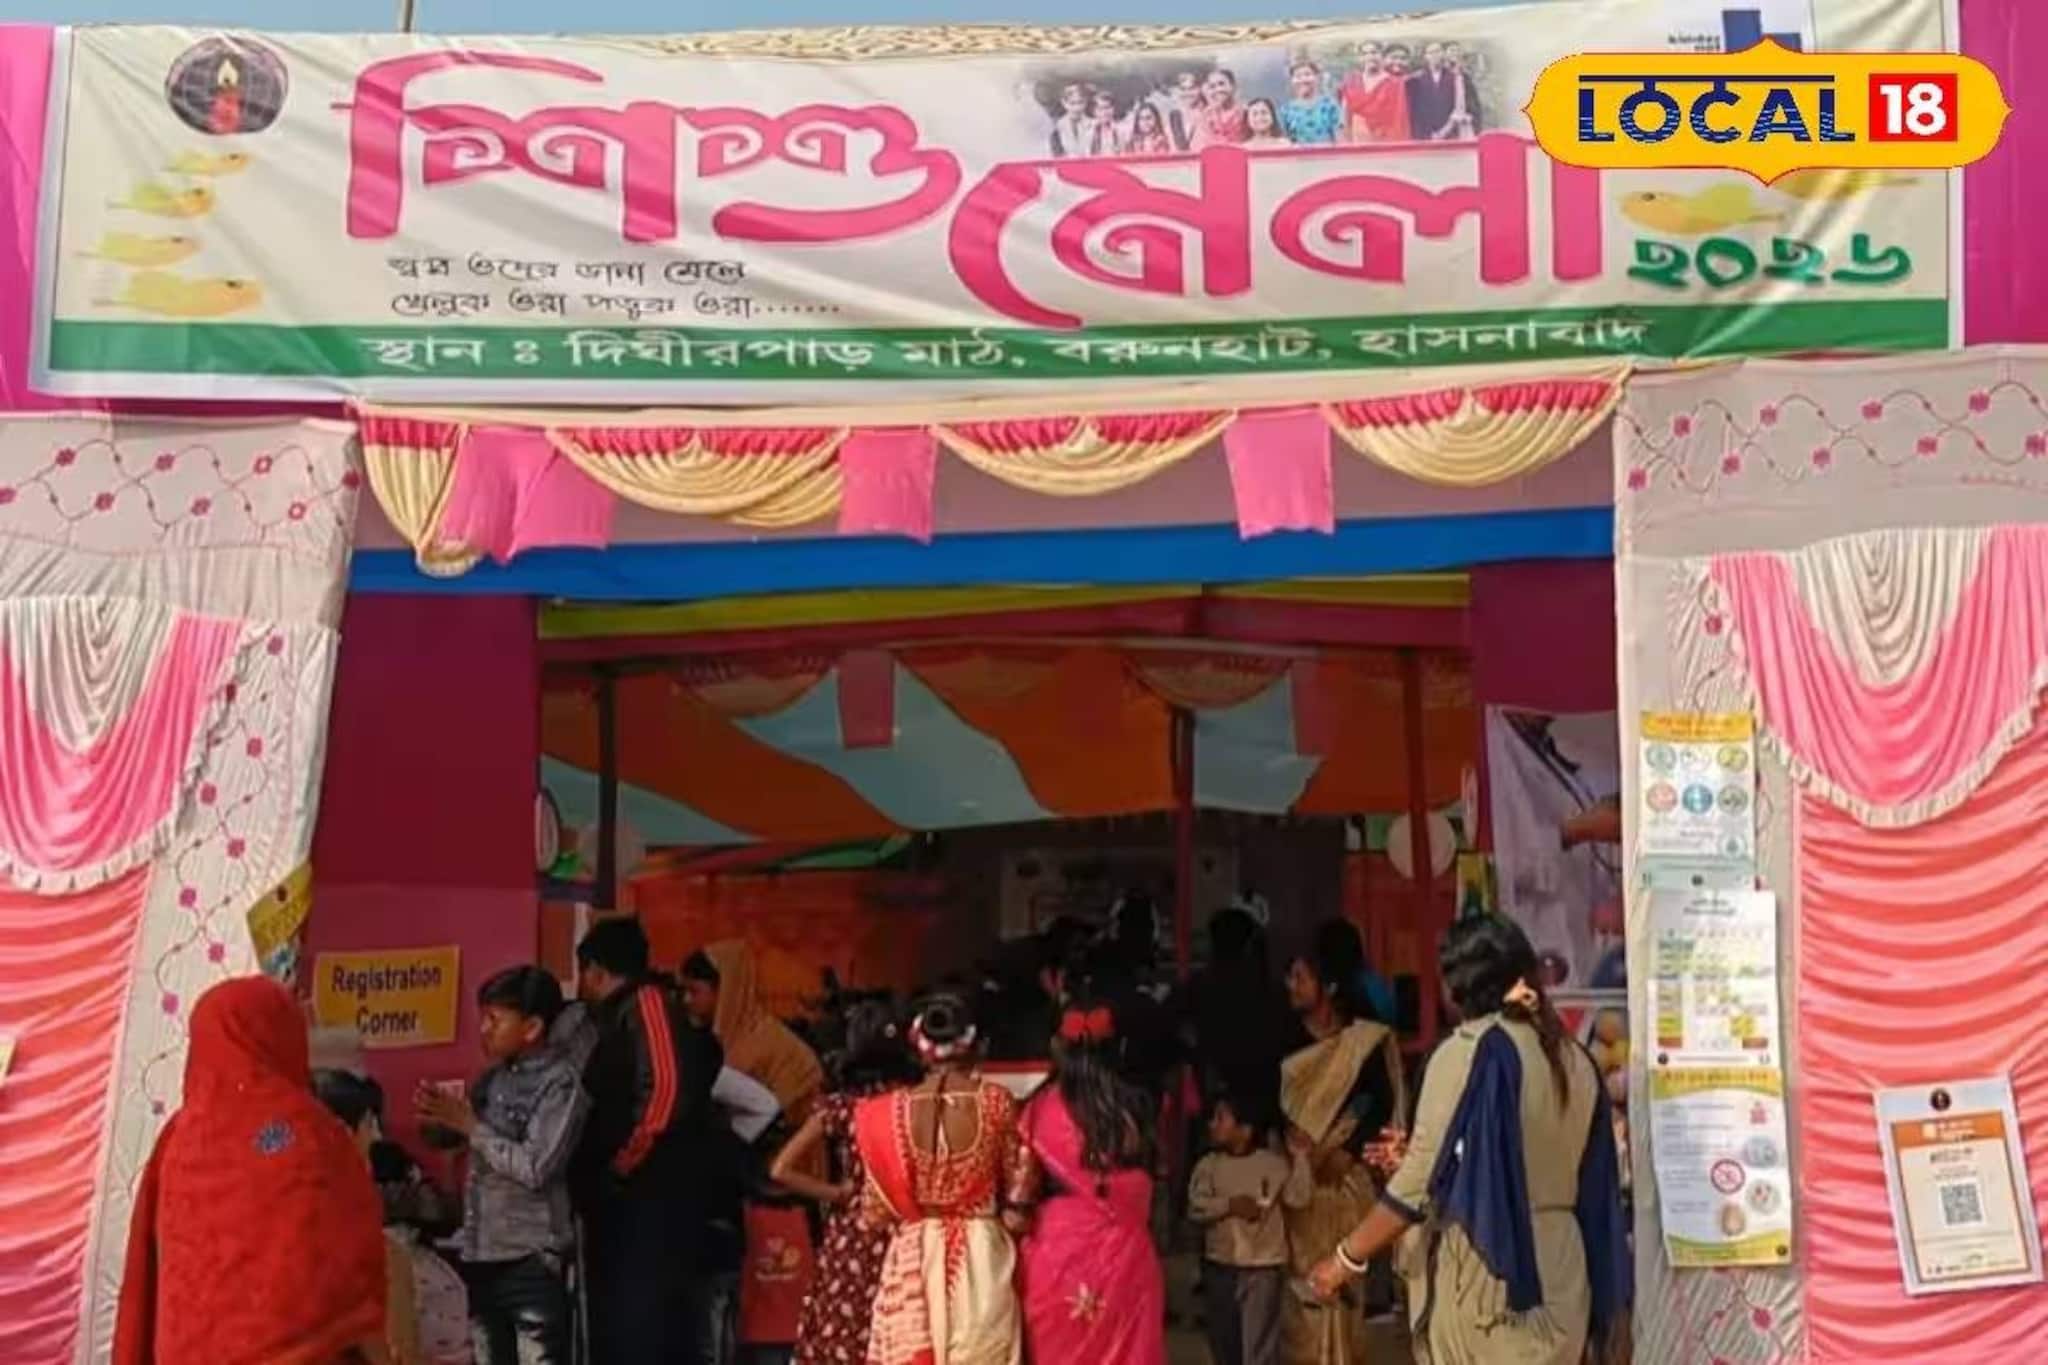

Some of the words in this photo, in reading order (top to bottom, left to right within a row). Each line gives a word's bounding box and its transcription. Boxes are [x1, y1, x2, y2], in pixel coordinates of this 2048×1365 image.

[331, 50, 963, 243] শিশু
[949, 132, 1602, 328] মেলা
[467, 252, 560, 282] ওদের
[575, 261, 645, 287] ডানা
[663, 259, 747, 287] মেলে
[1627, 233, 1911, 287] ২০২৬
[508, 287, 566, 315] ওরা
[360, 335, 486, 371] স্থান
[563, 329, 876, 371] দিঘীরপাড়
[1350, 318, 1658, 358] হাসনাবাদ
[331, 962, 443, 999] Registration
[355, 1005, 419, 1035] Corner
